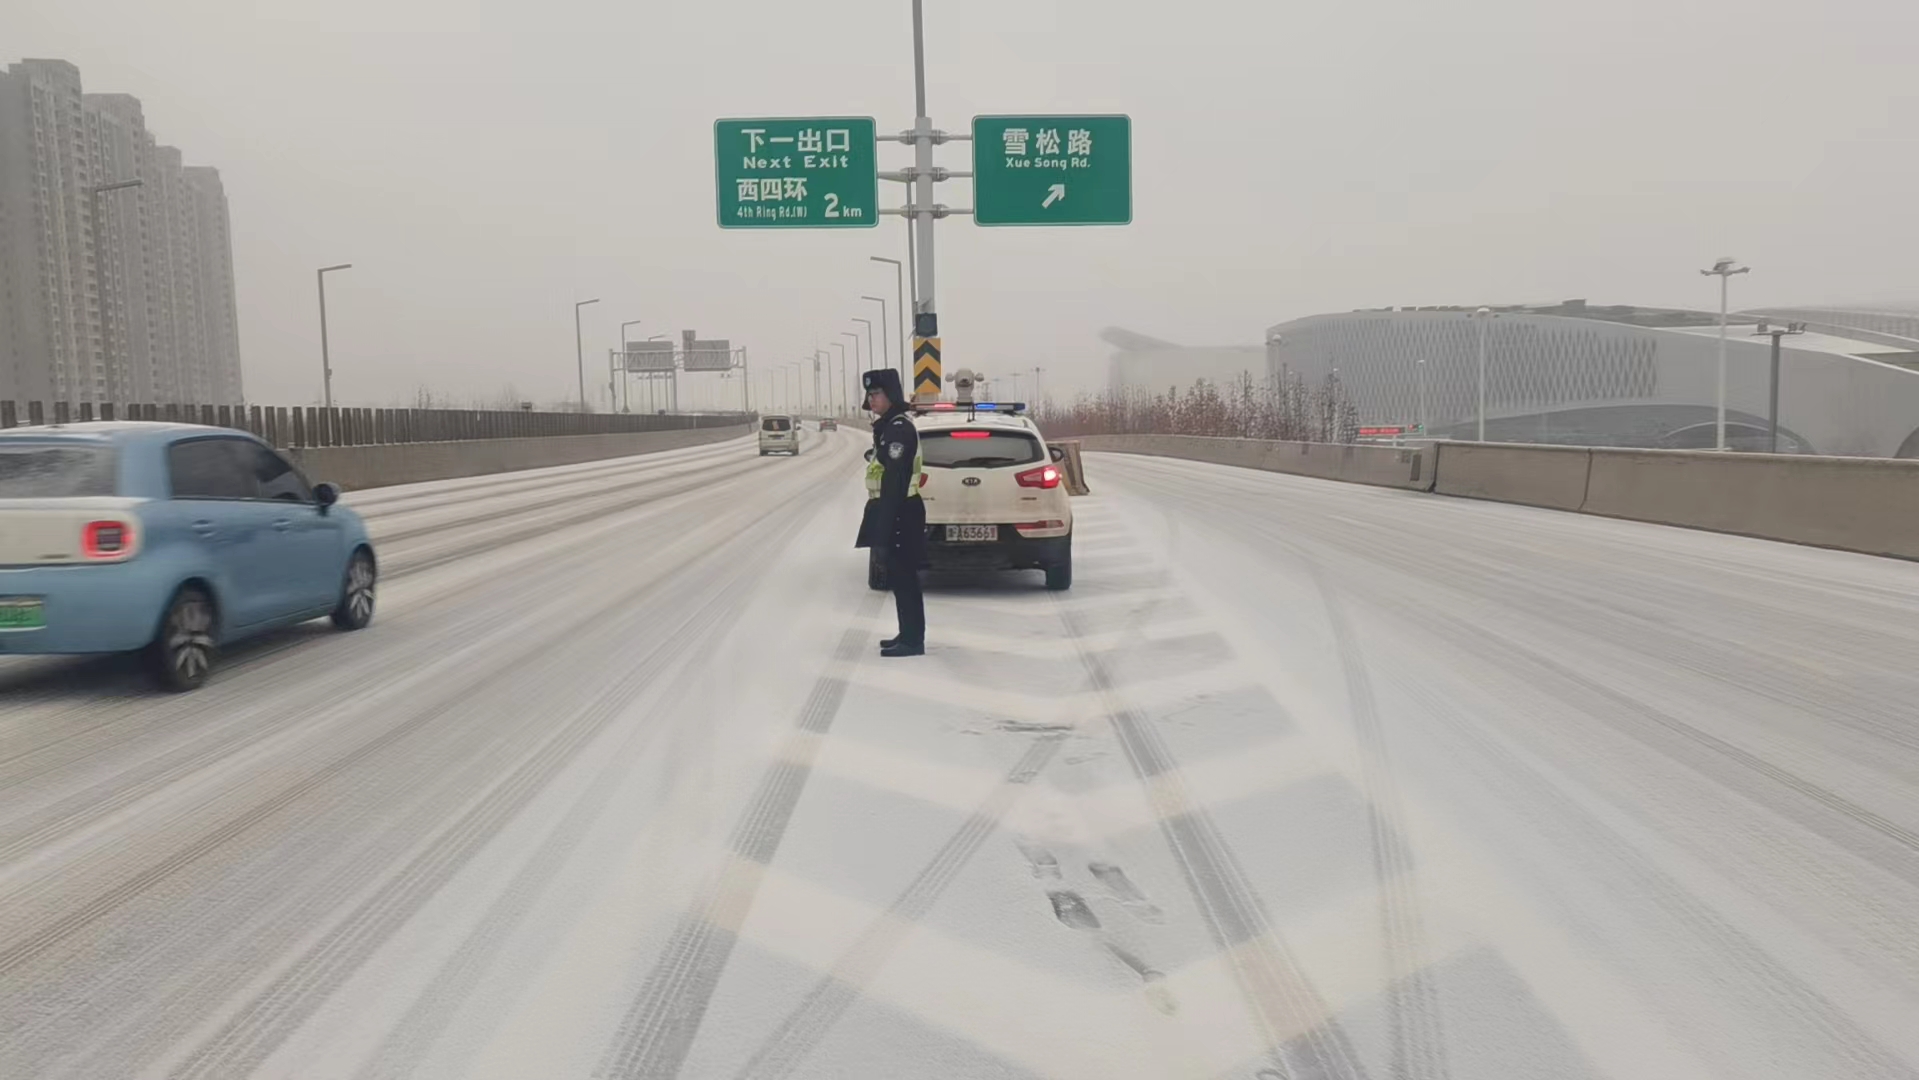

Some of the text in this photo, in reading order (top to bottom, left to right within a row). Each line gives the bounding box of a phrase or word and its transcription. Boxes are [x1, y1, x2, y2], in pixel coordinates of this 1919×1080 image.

[741, 128, 850, 153] 下一出口
[1003, 128, 1092, 155] 雪松路
[743, 155, 849, 169] Next Exit
[1005, 157, 1091, 171] Xue Song Rd.
[736, 177, 808, 202] 西四环
[737, 206, 754, 218] 4th
[756, 206, 776, 220] Ring
[824, 193, 862, 218] 2 km
